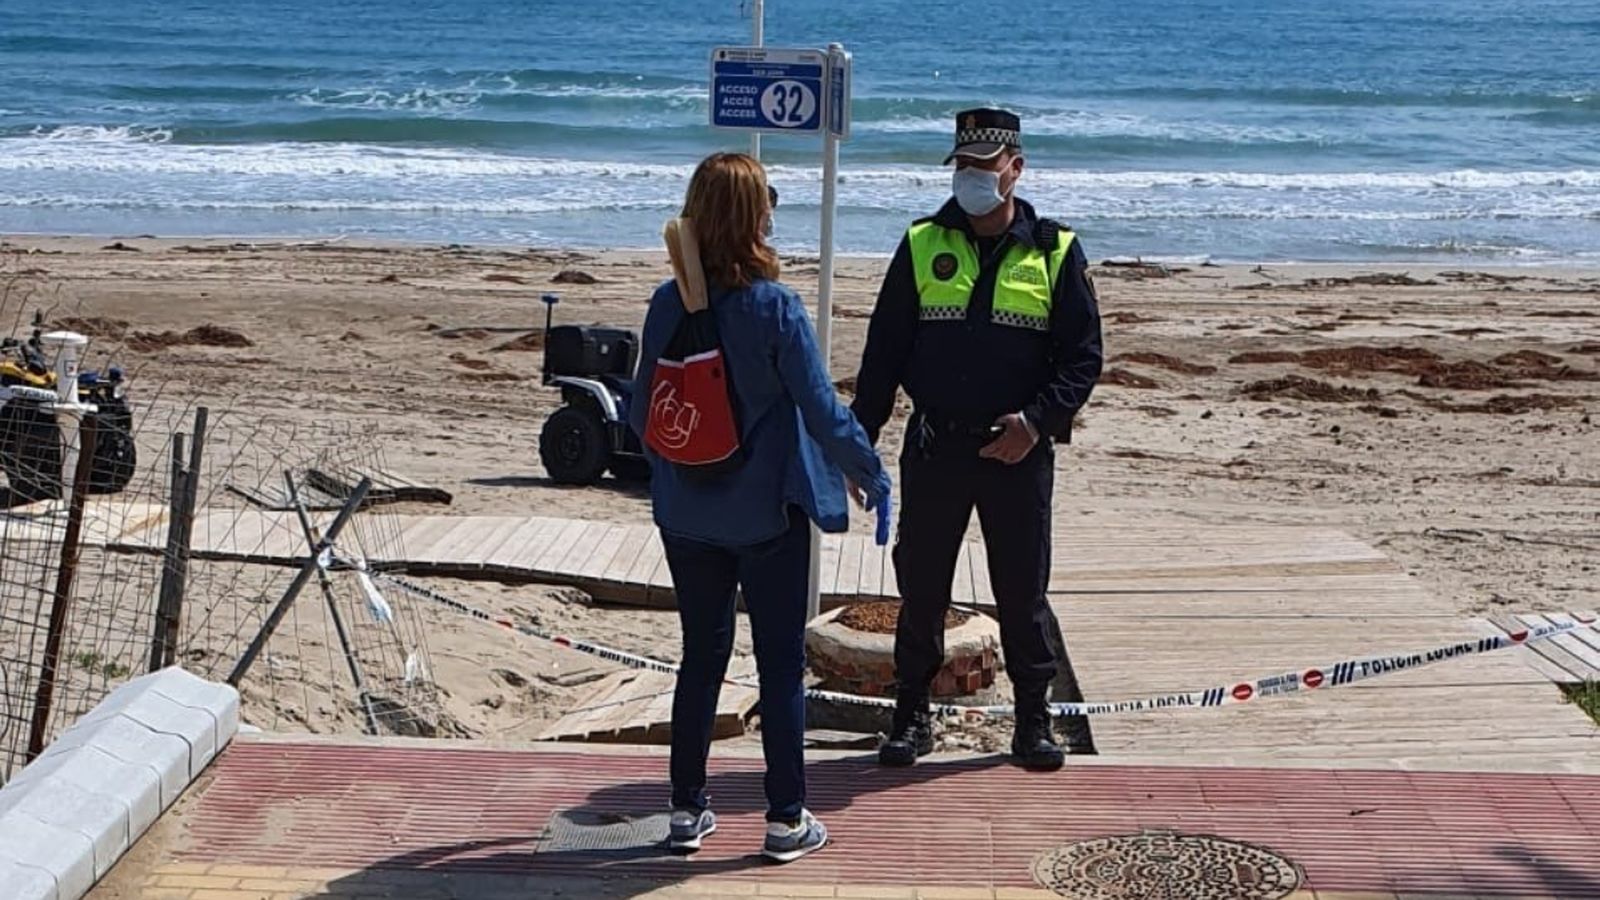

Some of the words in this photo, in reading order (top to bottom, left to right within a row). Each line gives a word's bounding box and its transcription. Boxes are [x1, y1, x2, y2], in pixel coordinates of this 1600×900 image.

[719, 85, 759, 94] ACCESO
[772, 84, 803, 122] 32
[719, 108, 756, 118] ACCESS
